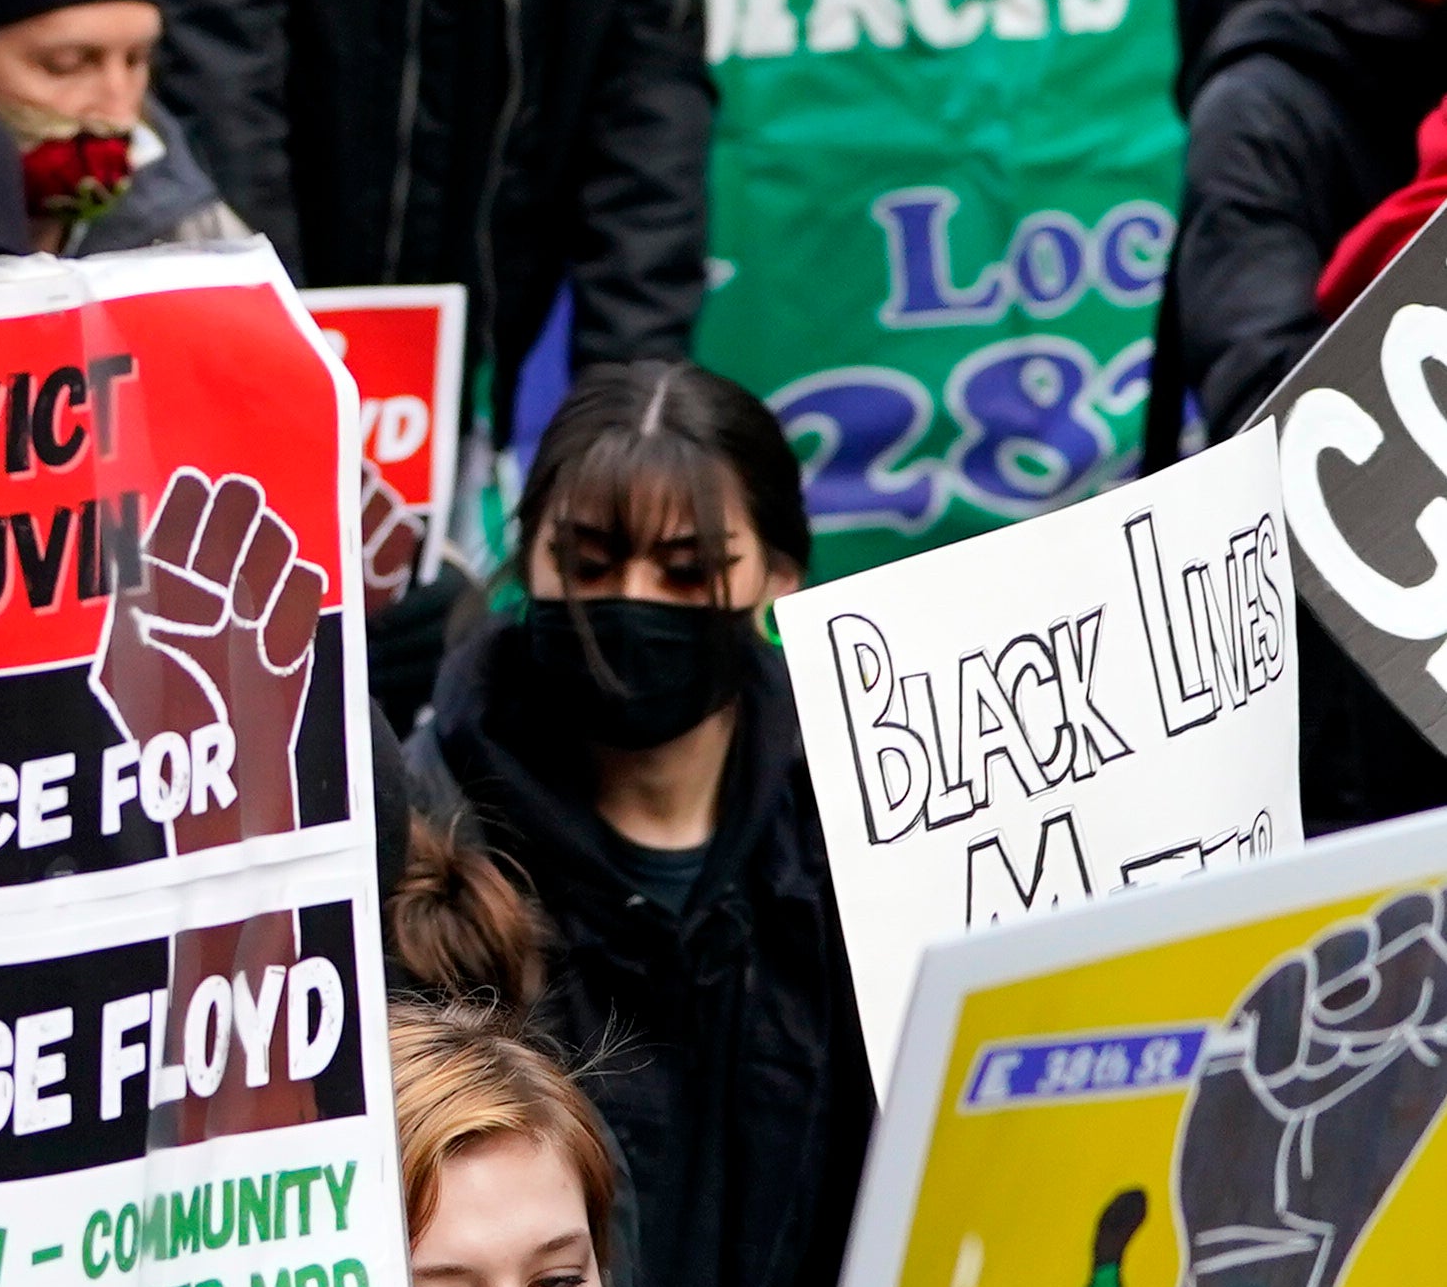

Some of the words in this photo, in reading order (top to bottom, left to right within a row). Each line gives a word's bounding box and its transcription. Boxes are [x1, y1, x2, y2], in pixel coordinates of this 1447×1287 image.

[829, 613, 1134, 846] BLACK
[1123, 507, 1288, 739] LIVES
[101, 721, 238, 838] FOR
[99, 956, 346, 1122] FLOYD
[82, 1161, 358, 1280] COMMUNITY
